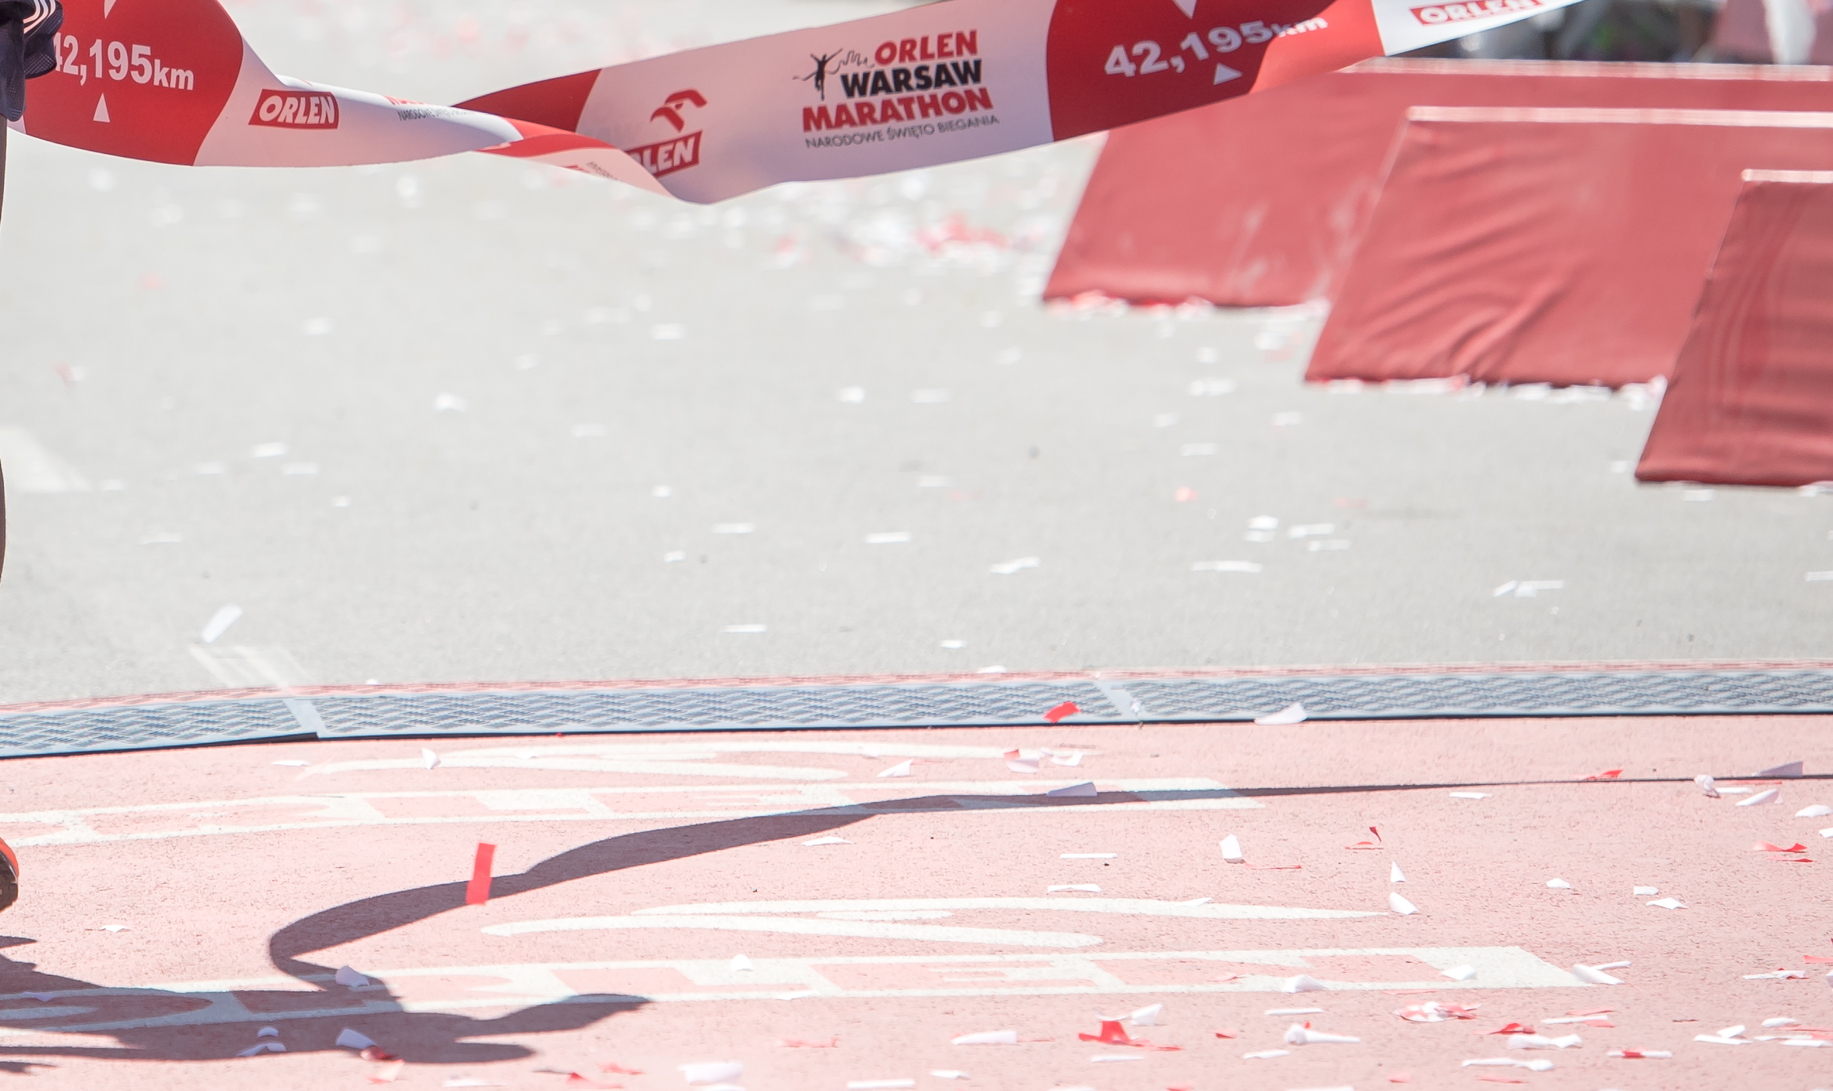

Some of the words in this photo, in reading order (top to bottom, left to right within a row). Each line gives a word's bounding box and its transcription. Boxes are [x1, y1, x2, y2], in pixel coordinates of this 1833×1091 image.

[874, 29, 978, 66] ORLEN
[1104, 17, 1329, 77] 42,195km
[840, 59, 983, 98] WARSAW
[259, 95, 335, 125] ORLEN
[803, 87, 994, 133] MARATHON
[805, 130, 884, 149] NARODOWE
[886, 122, 935, 139] ŚWIĘTO
[937, 114, 1000, 133] BIEGANIA
[630, 137, 695, 173] LEN
